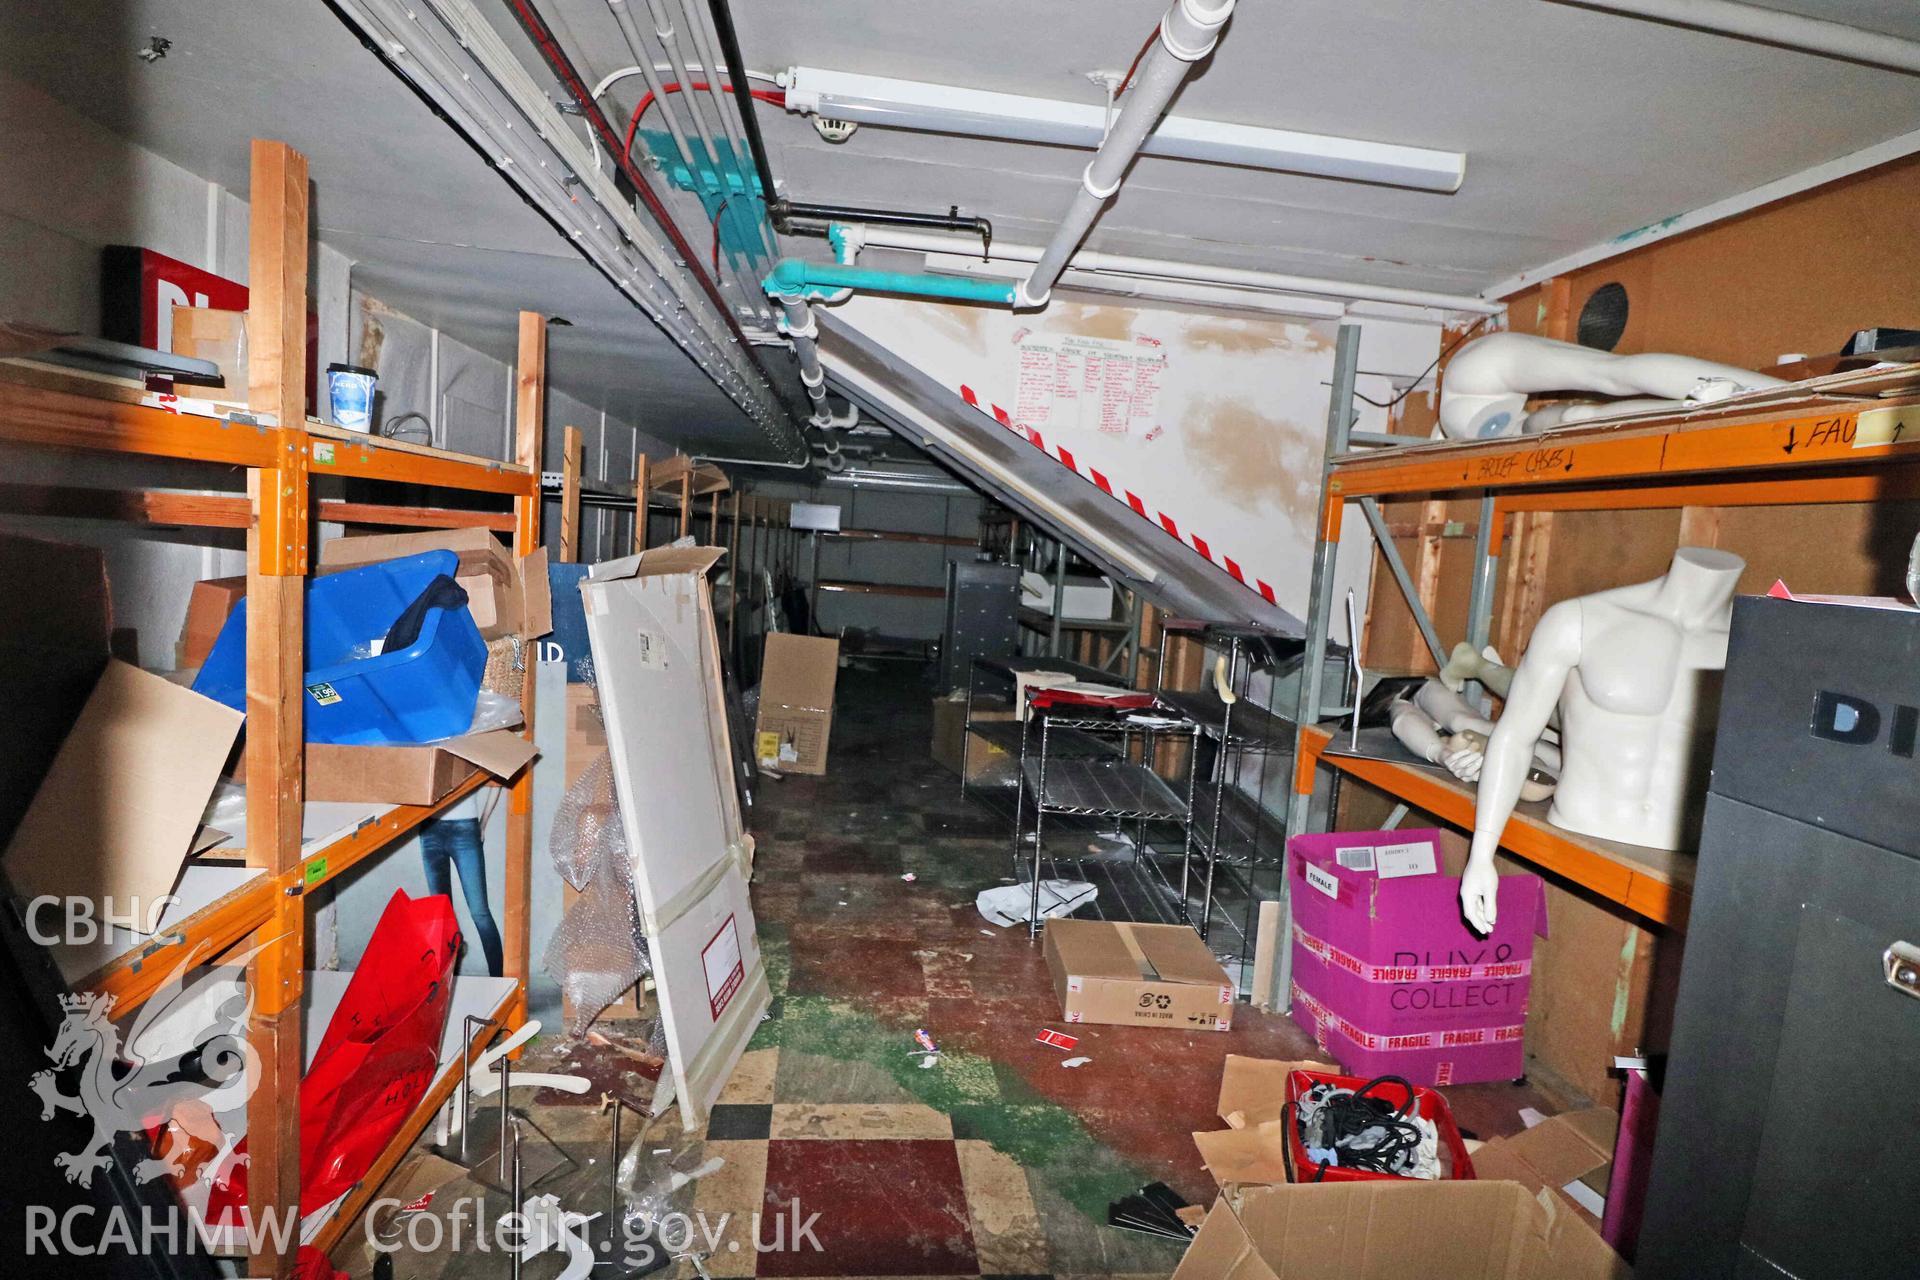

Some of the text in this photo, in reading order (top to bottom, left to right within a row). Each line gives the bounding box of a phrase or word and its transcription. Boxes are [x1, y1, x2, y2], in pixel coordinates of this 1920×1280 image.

[1526, 449, 1564, 473] CASES
[1309, 872, 1333, 891] FEMALE
[1330, 948, 1361, 974] FRAGILE
[1484, 962, 1522, 977] FRAGILE
[1372, 968, 1417, 980] FRAGILE
[1429, 967, 1472, 979] FRAGILE
[1391, 983, 1515, 1011] COLLECT
[1340, 1021, 1375, 1048] FRAGILE
[1388, 1036, 1431, 1048] FRAGILE
[1443, 1031, 1484, 1044] FRAGILE
